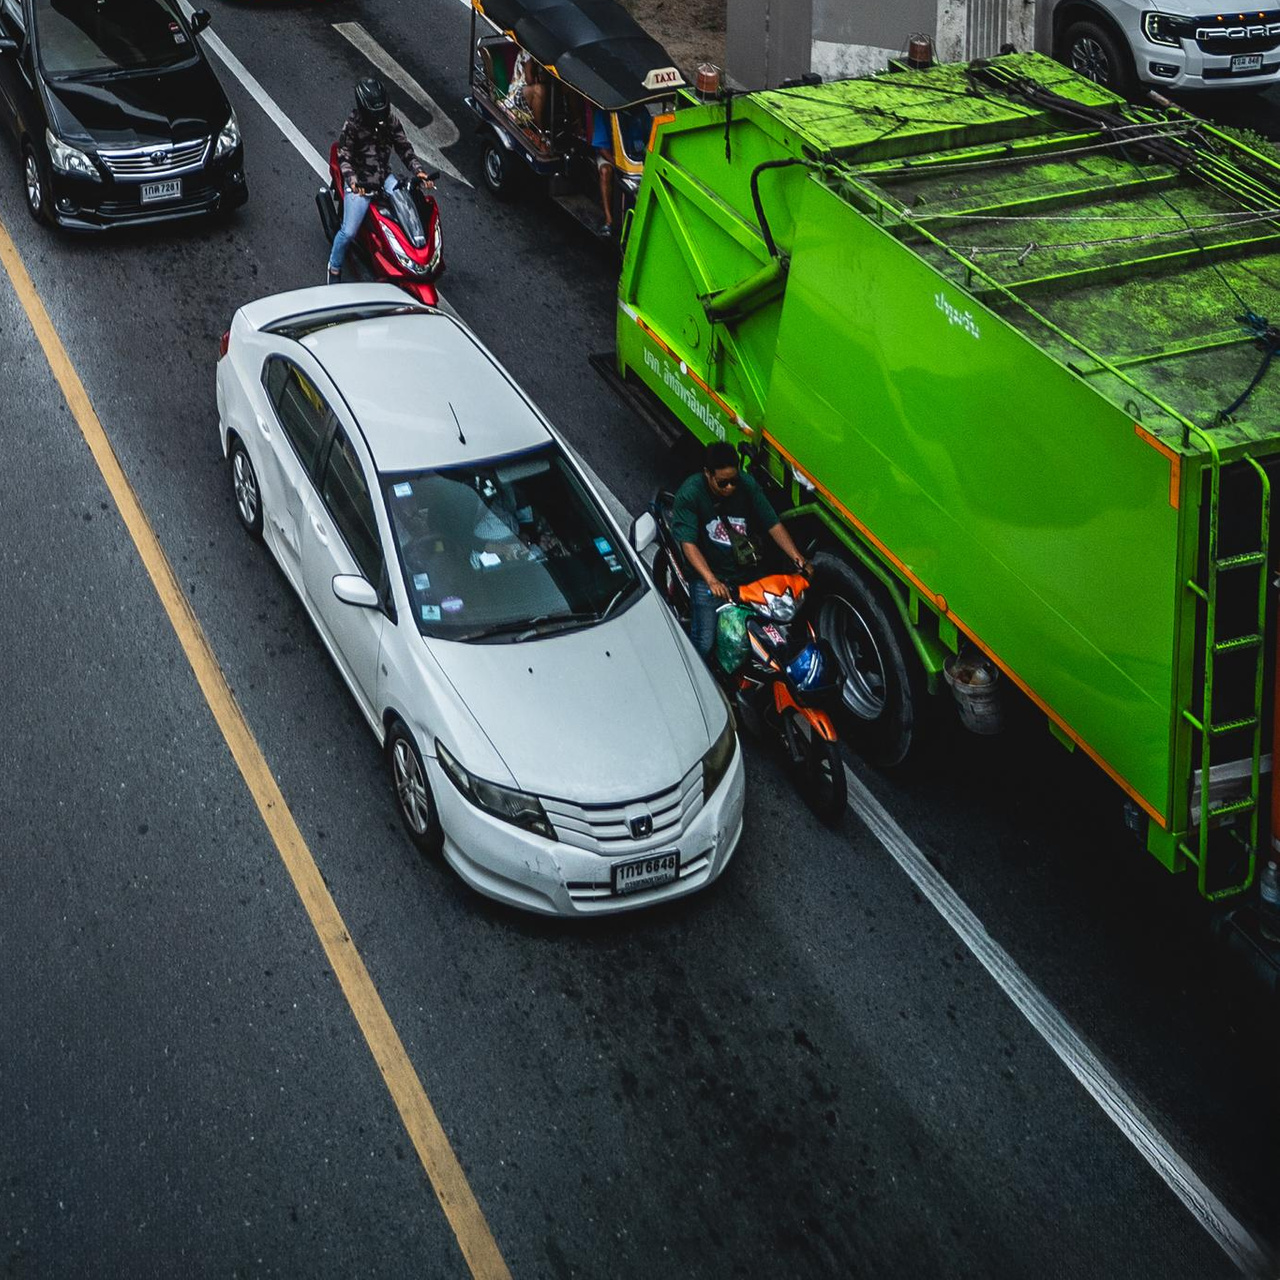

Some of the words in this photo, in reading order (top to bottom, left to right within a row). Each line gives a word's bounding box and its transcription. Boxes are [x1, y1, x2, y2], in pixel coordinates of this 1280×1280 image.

[654, 71, 677, 84] TAXI
[934, 291, 980, 339] ปทุมวัน
[645, 856, 675, 874] 6648
